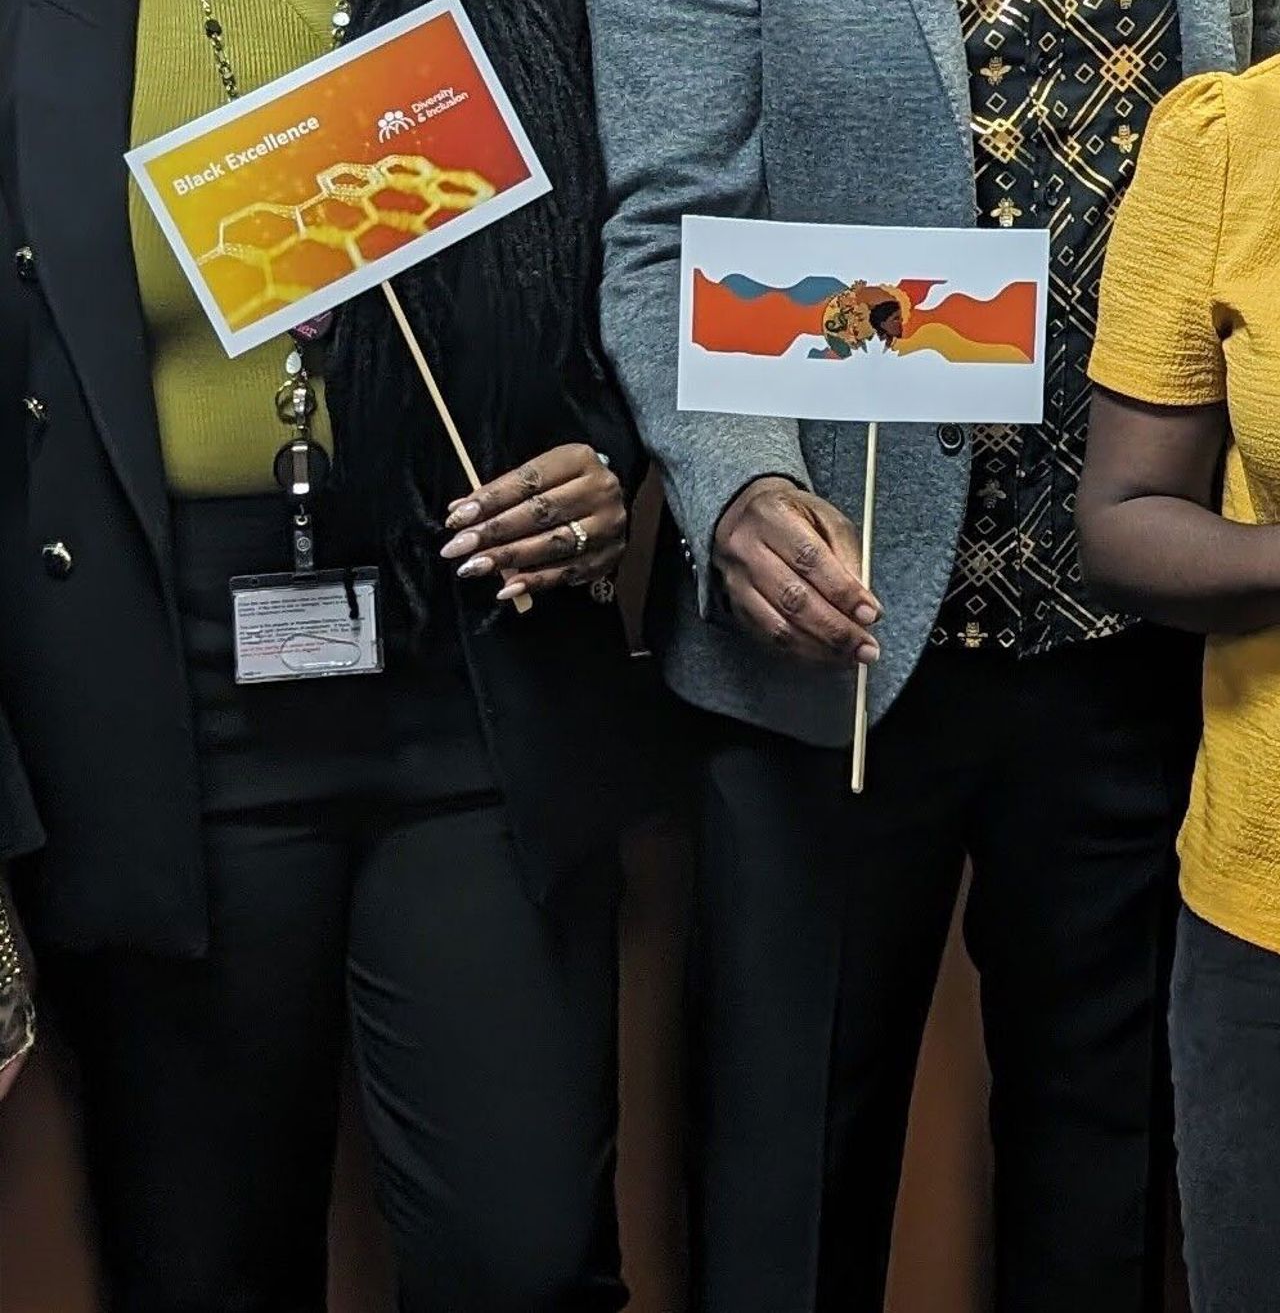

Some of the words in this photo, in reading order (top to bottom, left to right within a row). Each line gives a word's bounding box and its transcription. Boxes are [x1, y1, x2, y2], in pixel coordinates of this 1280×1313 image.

[411, 86, 455, 115] Diversity
[417, 112, 427, 124] &
[426, 90, 469, 120] Inclusion
[172, 161, 225, 198] Black
[225, 116, 321, 173] Excellence
